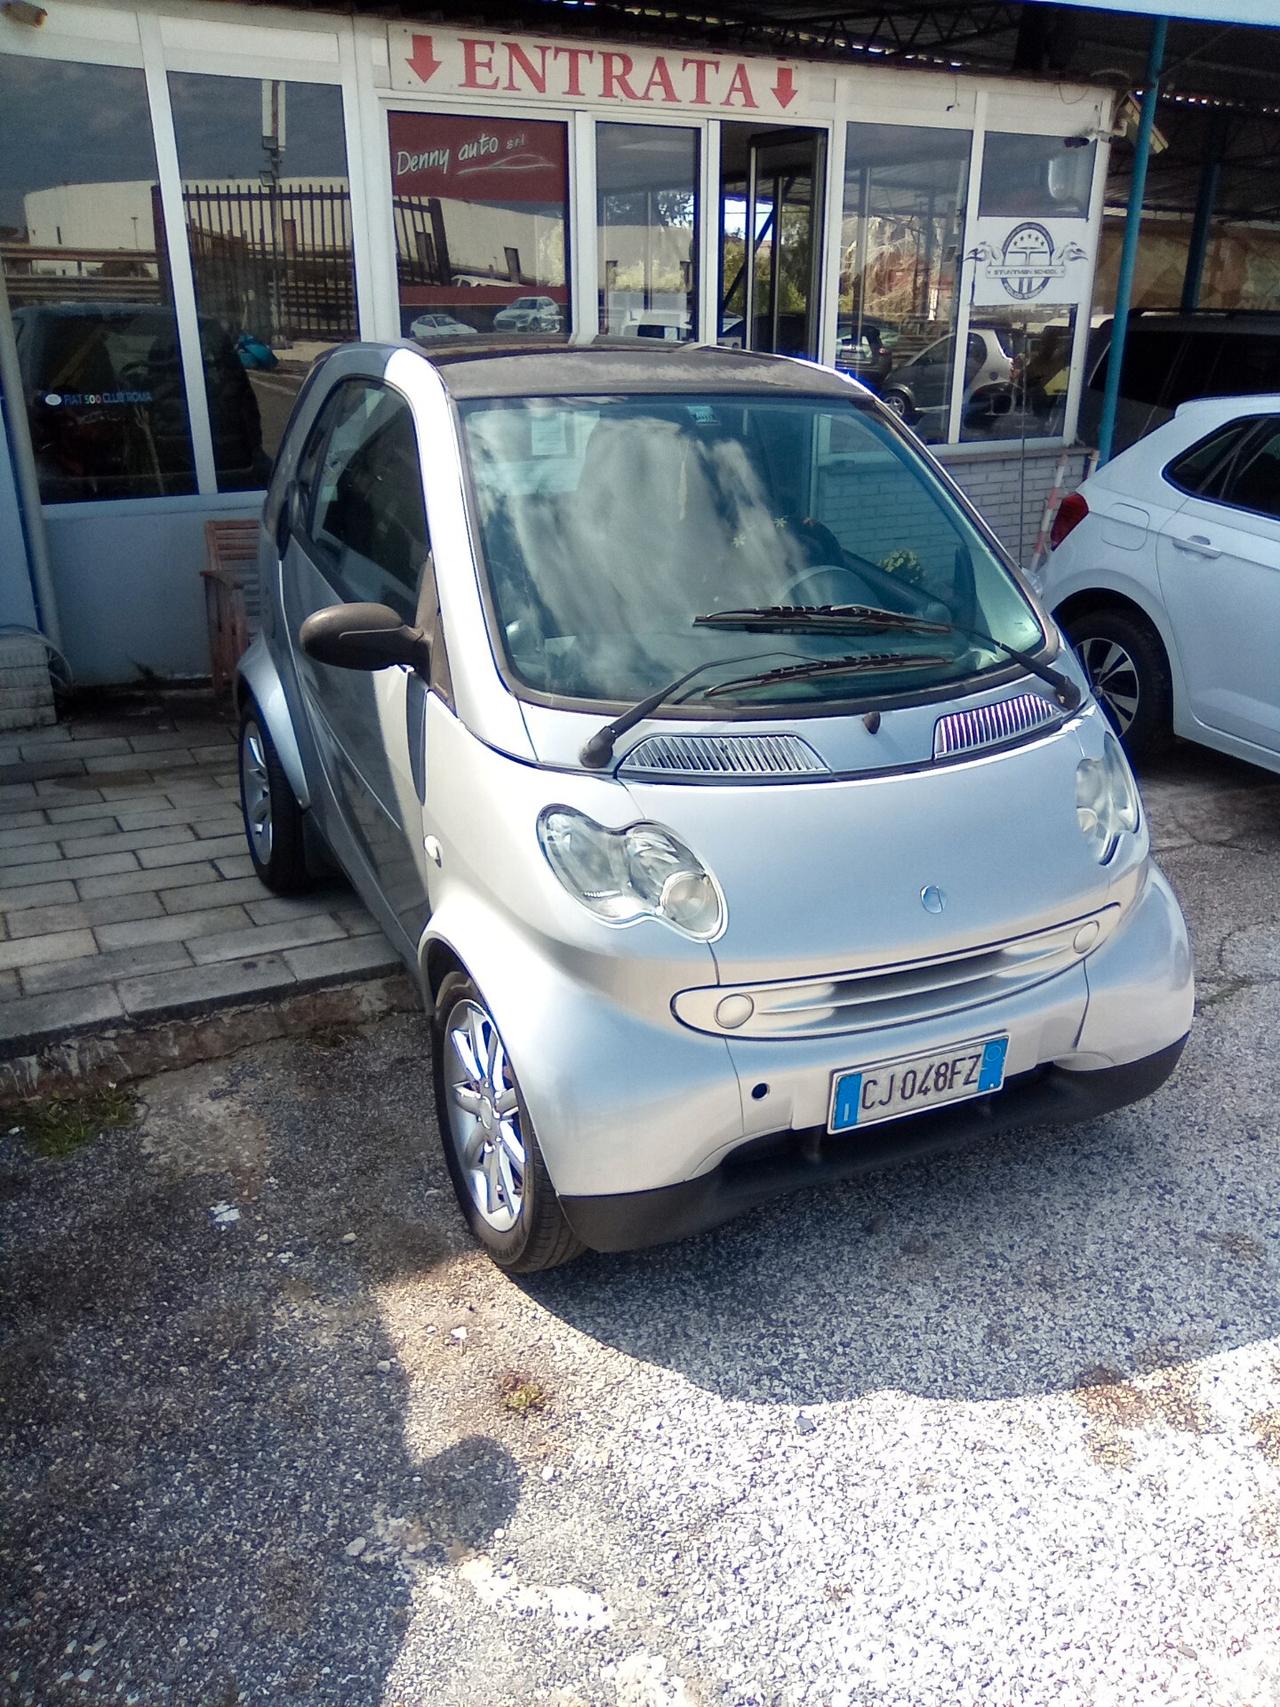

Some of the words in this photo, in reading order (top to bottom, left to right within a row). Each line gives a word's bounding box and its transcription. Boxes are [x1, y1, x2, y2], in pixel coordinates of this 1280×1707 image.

[457, 38, 759, 109] ENTRATA
[397, 148, 450, 175] Denny
[458, 133, 499, 160] auto
[64, 393, 82, 406] FIAT
[84, 394, 101, 405] 500
[103, 392, 125, 404] CLUB
[126, 391, 152, 403] ROMA
[861, 1053, 982, 1110] CJ048FZ
